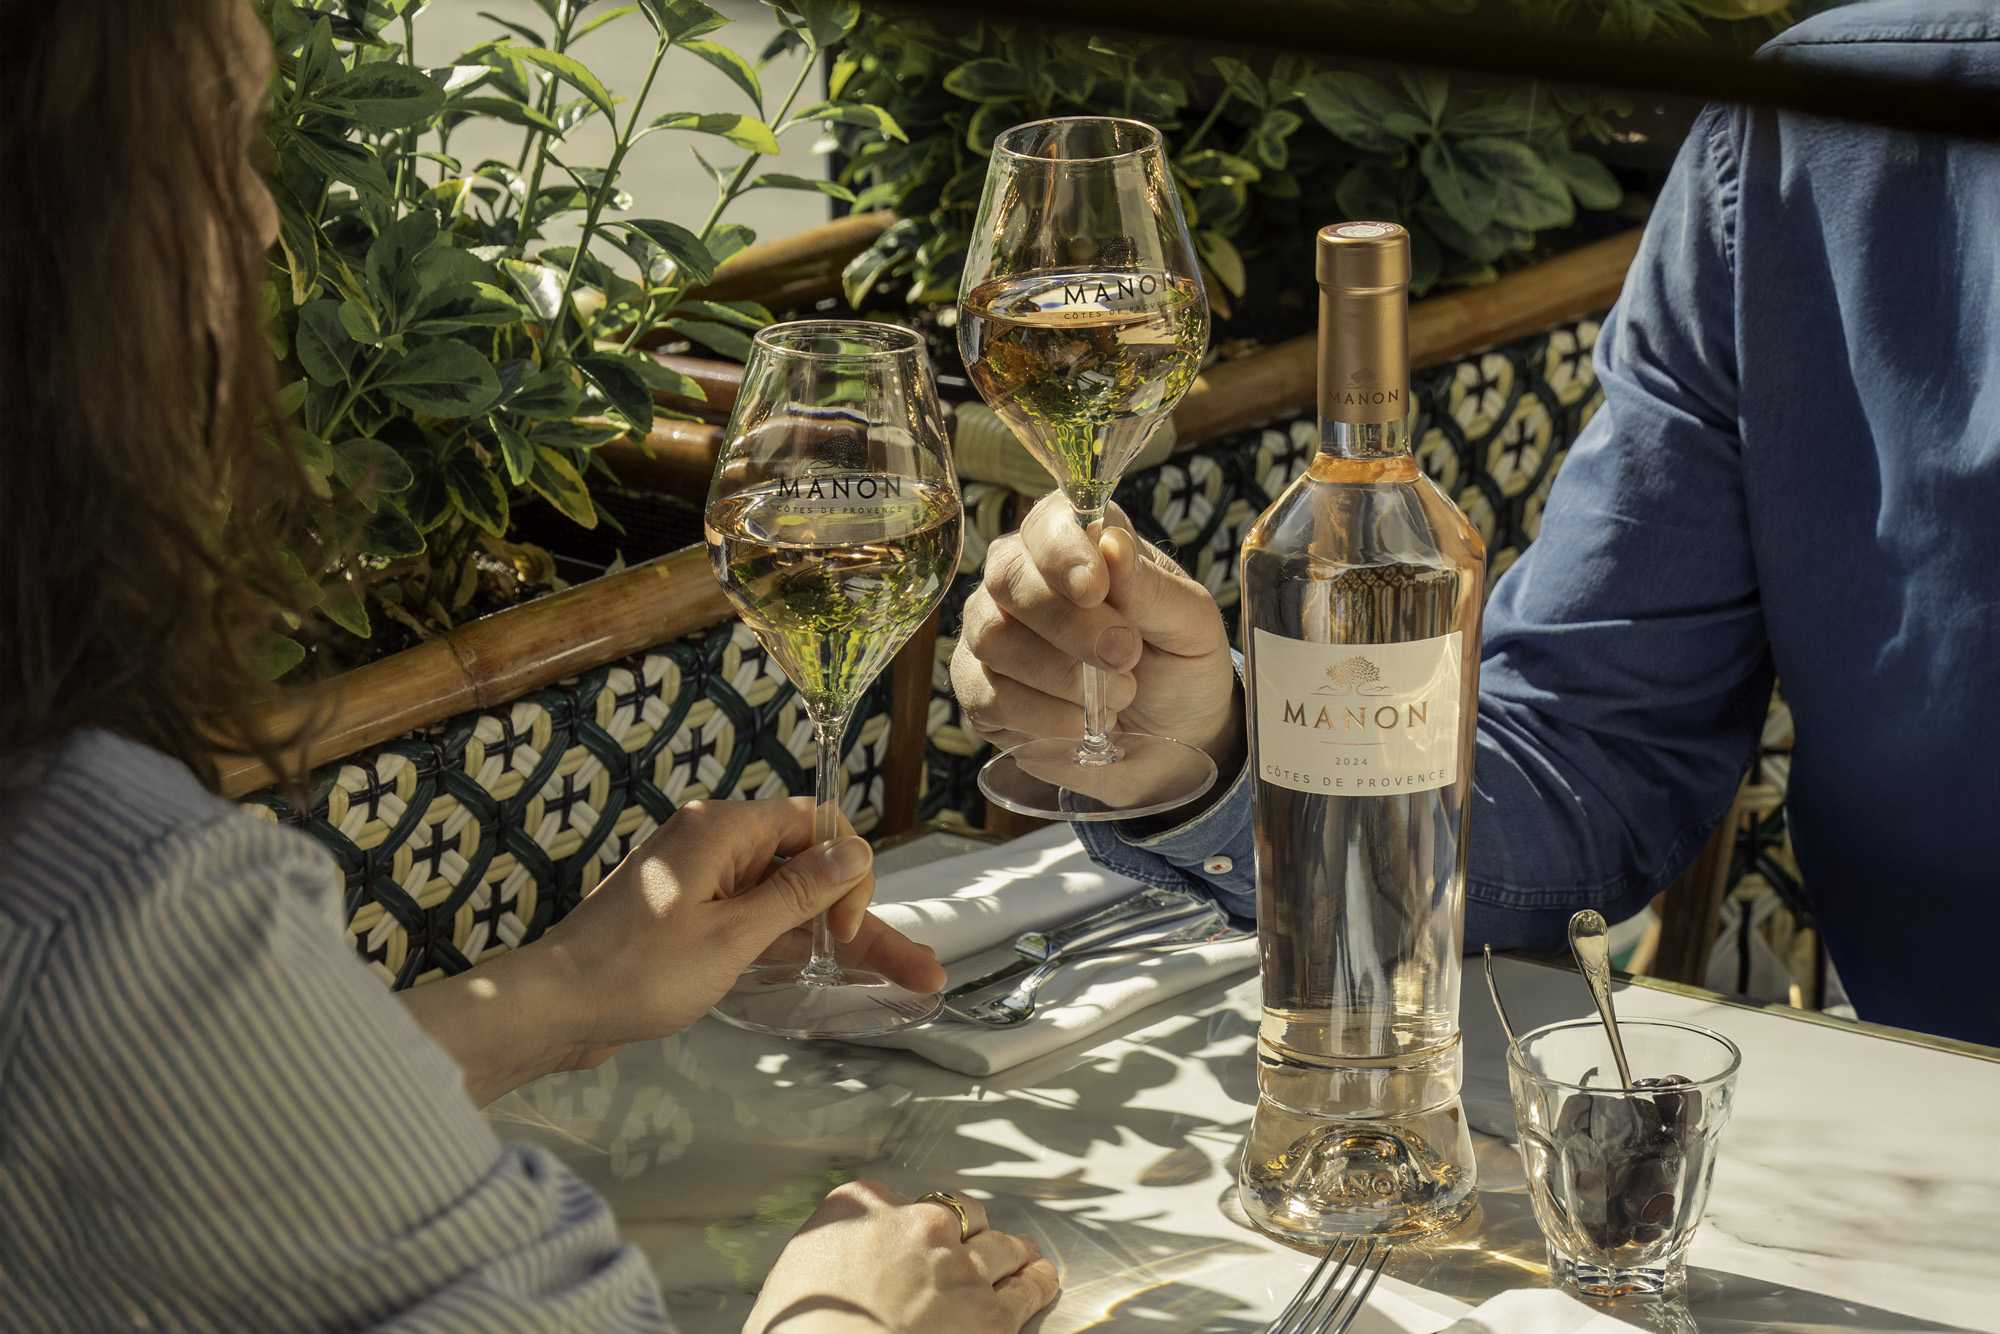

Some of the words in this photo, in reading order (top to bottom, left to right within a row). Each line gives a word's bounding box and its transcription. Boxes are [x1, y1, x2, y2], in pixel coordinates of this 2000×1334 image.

[1063, 268, 1176, 305] MANON
[1328, 389, 1399, 405] MANON
[777, 476, 901, 499] MANON
[776, 503, 813, 513] CÔTES
[842, 505, 904, 514] PROVENCE
[1283, 699, 1430, 730] MANON
[1335, 756, 1368, 766] 2024
[1265, 764, 1311, 784] CÔTES
[1322, 776, 1344, 787] DE
[1356, 768, 1446, 788] PROVENCE
